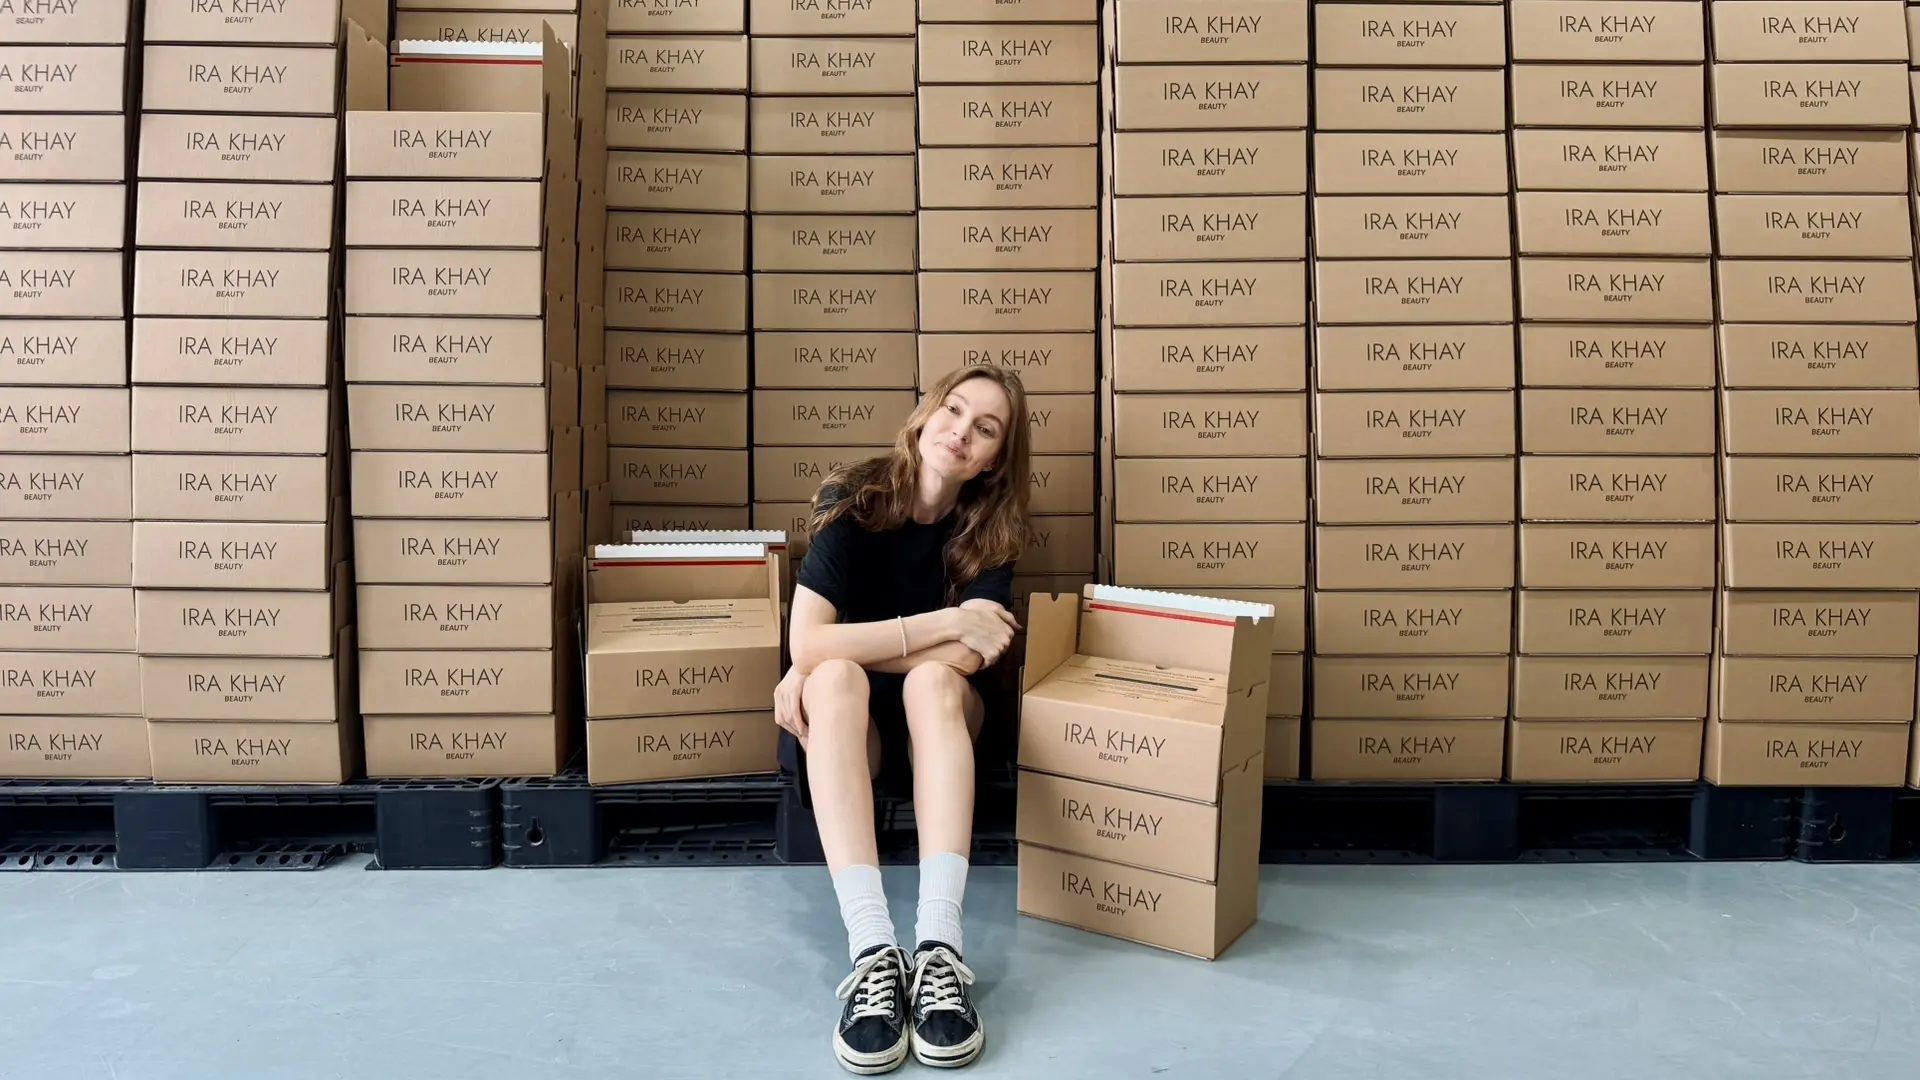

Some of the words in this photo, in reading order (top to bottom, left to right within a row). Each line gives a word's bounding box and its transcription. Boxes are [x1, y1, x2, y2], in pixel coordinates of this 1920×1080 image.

[1166, 16, 1199, 34] IRA
[1207, 15, 1262, 34] KHAY
[1362, 20, 1395, 38] IRA
[1403, 20, 1457, 39] KHAY
[1559, 15, 1593, 33] IRA
[1601, 15, 1656, 33] KHAY
[1762, 17, 1797, 34] IRA
[1804, 16, 1859, 35] KHAY
[962, 40, 994, 57] IRA
[1001, 39, 1052, 57] KHAY
[1200, 34, 1229, 44] BEAUTY
[1396, 40, 1425, 48] BEAUTY
[1594, 35, 1624, 43] BEAUTY
[1798, 35, 1828, 44] BEAUTY
[619, 49, 649, 64] IRA
[656, 49, 705, 65] KHAY
[791, 52, 821, 68] IRA
[825, 52, 876, 70] KHAY
[995, 57, 1022, 66] BEAUTY
[189, 64, 222, 83] IRA
[231, 65, 287, 84] KHAY
[223, 86, 253, 94] BEAUTY
[1764, 80, 1798, 98] IRA
[1804, 80, 1861, 100] KHAY
[1799, 100, 1829, 108] BEAUTY
[617, 107, 648, 124] IRA
[653, 108, 702, 125] KHAY
[790, 112, 820, 128] IRA
[826, 111, 875, 128] KHAY
[647, 125, 673, 133] BEAUTY
[393, 129, 427, 148] IRA
[436, 129, 492, 148] KHAY
[428, 151, 458, 159] BEAUTY
[1162, 148, 1195, 167] IRA
[1204, 147, 1259, 167] KHAY
[1362, 149, 1396, 167] IRA
[1403, 149, 1458, 167] KHAY
[790, 170, 819, 187] IRA
[826, 170, 874, 188] KHAY
[964, 164, 995, 181] IRA
[1002, 163, 1054, 181] KHAY
[1196, 168, 1226, 176] BEAUTY
[1397, 168, 1426, 176] BEAUTY
[820, 188, 846, 196] BEAUTY
[996, 183, 1023, 191] BEAUTY
[1565, 208, 1600, 226] IRA
[1607, 208, 1662, 227] KHAY
[963, 226, 994, 243] IRA
[1001, 225, 1052, 243] KHAY
[995, 245, 1022, 253] BEAUTY
[393, 267, 426, 286] IRA
[435, 267, 492, 286] KHAY
[1365, 277, 1399, 295] IRA
[1407, 276, 1463, 295] KHAY
[428, 288, 458, 296] BEAUTY
[1160, 279, 1193, 297] IRA
[1202, 278, 1257, 297] KHAY
[1768, 276, 1803, 294] IRA
[1808, 276, 1866, 296] KHAY
[619, 286, 649, 304] IRA
[655, 287, 704, 305] KHAY
[793, 288, 822, 305] IRA
[829, 289, 877, 306] KHAY
[963, 288, 994, 305] IRA
[1001, 287, 1052, 305] KHAY
[1195, 299, 1224, 307] BEAUTY
[1401, 297, 1431, 305] BEAUTY
[1805, 296, 1834, 304] BEAUTY
[649, 305, 674, 313] BEAUTY
[995, 307, 1022, 315] BEAUTY
[179, 336, 212, 355] IRA
[221, 337, 278, 357] KHAY
[1569, 340, 1603, 359] IRA
[1611, 340, 1666, 359] KHAY
[214, 358, 243, 366] BEAUTY
[794, 347, 823, 364] IRA
[830, 347, 877, 365] KHAY
[1605, 361, 1634, 369] BEAUTY
[395, 403, 430, 422] IRA
[438, 403, 495, 423] KHAY
[1163, 411, 1196, 429] IRA
[1204, 410, 1260, 429] KHAY
[1366, 409, 1401, 428] IRA
[1409, 409, 1466, 428] KHAY
[1775, 407, 1810, 426] IRA
[1818, 407, 1874, 428] KHAY
[432, 424, 462, 432] BEAUTY
[1197, 431, 1227, 439] BEAUTY
[1402, 430, 1432, 438] BEAUTY
[1811, 428, 1841, 436] BEAUTY
[623, 462, 652, 479] IRA
[659, 463, 707, 481] KHAY
[1570, 473, 1604, 492] IRA
[1612, 473, 1667, 494] KHAY
[1605, 494, 1635, 502] BEAUTY
[179, 540, 212, 559] IRA
[221, 541, 277, 562] KHAY
[401, 537, 435, 556] IRA
[444, 537, 501, 558] KHAY
[1162, 541, 1195, 560] IRA
[1203, 541, 1259, 561] KHAY
[214, 561, 244, 570] BEAUTY
[437, 558, 467, 566] BEAUTY
[1196, 561, 1226, 569] BEAUTY
[182, 608, 216, 626] IRA
[224, 608, 281, 627] KHAY
[218, 629, 247, 637] BEAUTY
[2, 669, 35, 687] IRA
[42, 669, 96, 689] KHAY
[405, 668, 439, 686] IRA
[447, 668, 504, 687] KHAY
[636, 668, 670, 687] IRA
[679, 665, 734, 686] KHAY
[1361, 673, 1396, 692] IRA
[1403, 672, 1460, 693] KHAY
[1564, 672, 1597, 691] IRA
[1606, 672, 1661, 692] KHAY
[36, 690, 65, 698] BEAUTY
[440, 687, 470, 697] BEAUTY
[672, 687, 702, 696] BEAUTY
[1396, 692, 1425, 701] BEAUTY
[1598, 693, 1627, 701] BEAUTY
[9, 733, 42, 751] IRA
[49, 733, 103, 751] KHAY
[194, 738, 229, 756] IRA
[236, 738, 291, 756] KHAY
[637, 734, 671, 753] IRA
[680, 730, 735, 751] KHAY
[1064, 722, 1097, 747] IRA
[1106, 729, 1166, 758] KHAY
[1766, 740, 1799, 758] IRA
[1807, 740, 1863, 758] KHAY
[44, 753, 72, 761] BEAUTY
[231, 757, 260, 766] BEAUTY
[672, 752, 702, 761] BEAUTY
[1098, 752, 1129, 764] BEAUTY
[1061, 798, 1095, 824] IRA
[1104, 806, 1163, 836] KHAY
[1096, 828, 1126, 842] BEAUTY
[1061, 871, 1095, 898] IRA
[1103, 881, 1162, 912] KHAY
[1096, 902, 1126, 916] BEAUTY
